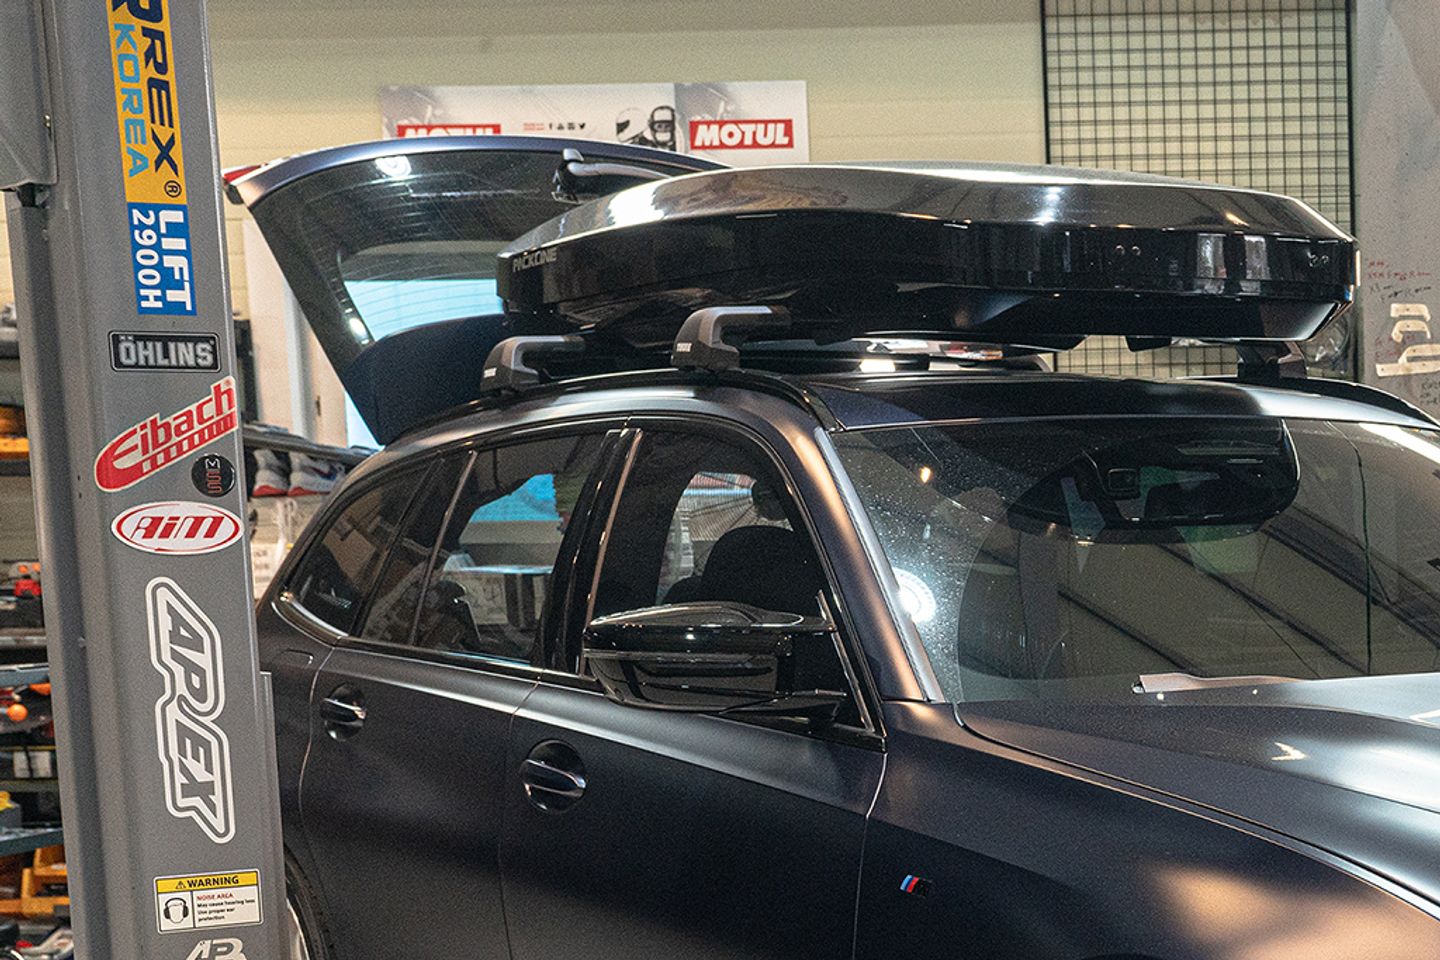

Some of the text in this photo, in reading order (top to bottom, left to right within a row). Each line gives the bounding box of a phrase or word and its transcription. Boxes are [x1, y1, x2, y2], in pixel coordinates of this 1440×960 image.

[113, 23, 149, 178] KOREA
[694, 123, 791, 147] MOTUL
[132, 208, 163, 310] 2900H
[158, 209, 192, 311] LIFT
[118, 335, 214, 367] ÖHLINS
[96, 383, 236, 490] Eibach
[155, 585, 227, 834] APEX
[187, 875, 239, 888] WARNING
